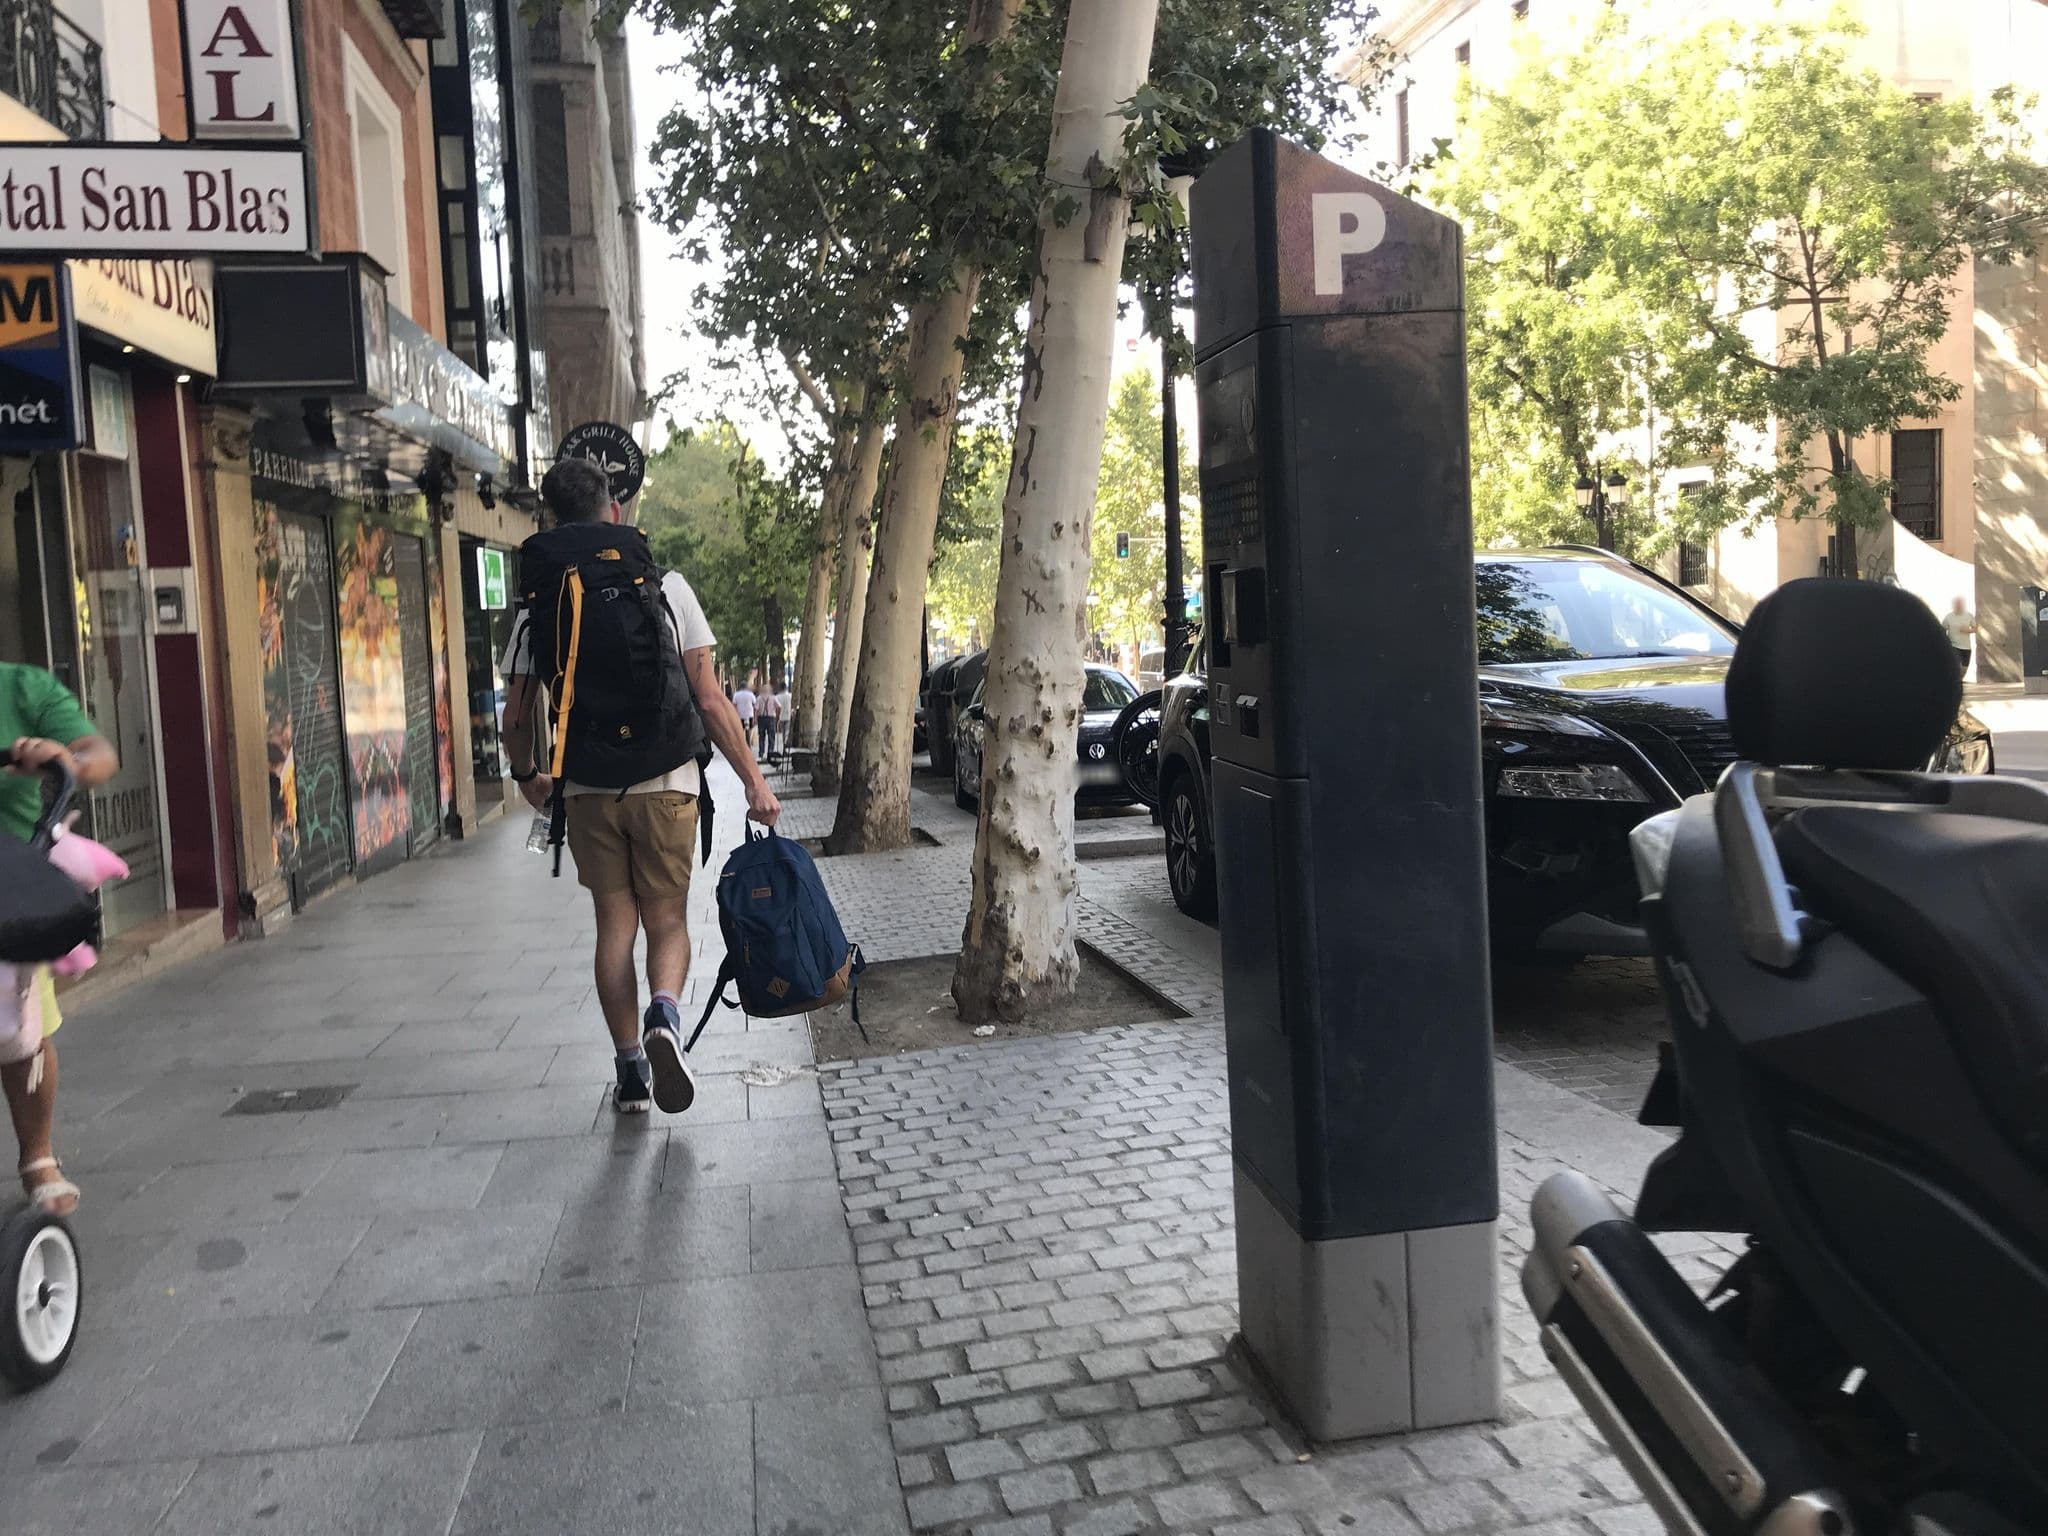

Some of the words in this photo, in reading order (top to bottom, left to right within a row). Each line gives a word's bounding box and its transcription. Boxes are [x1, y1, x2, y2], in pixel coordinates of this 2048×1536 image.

[0, 164, 66, 231] tal
[81, 167, 171, 232] San
[183, 168, 290, 234] Blas
[1312, 192, 1386, 296] P
[561, 434, 583, 461] EAK
[582, 426, 617, 440] GRILL
[619, 435, 641, 478] HOUSE
[95, 787, 154, 842] ELCOME
